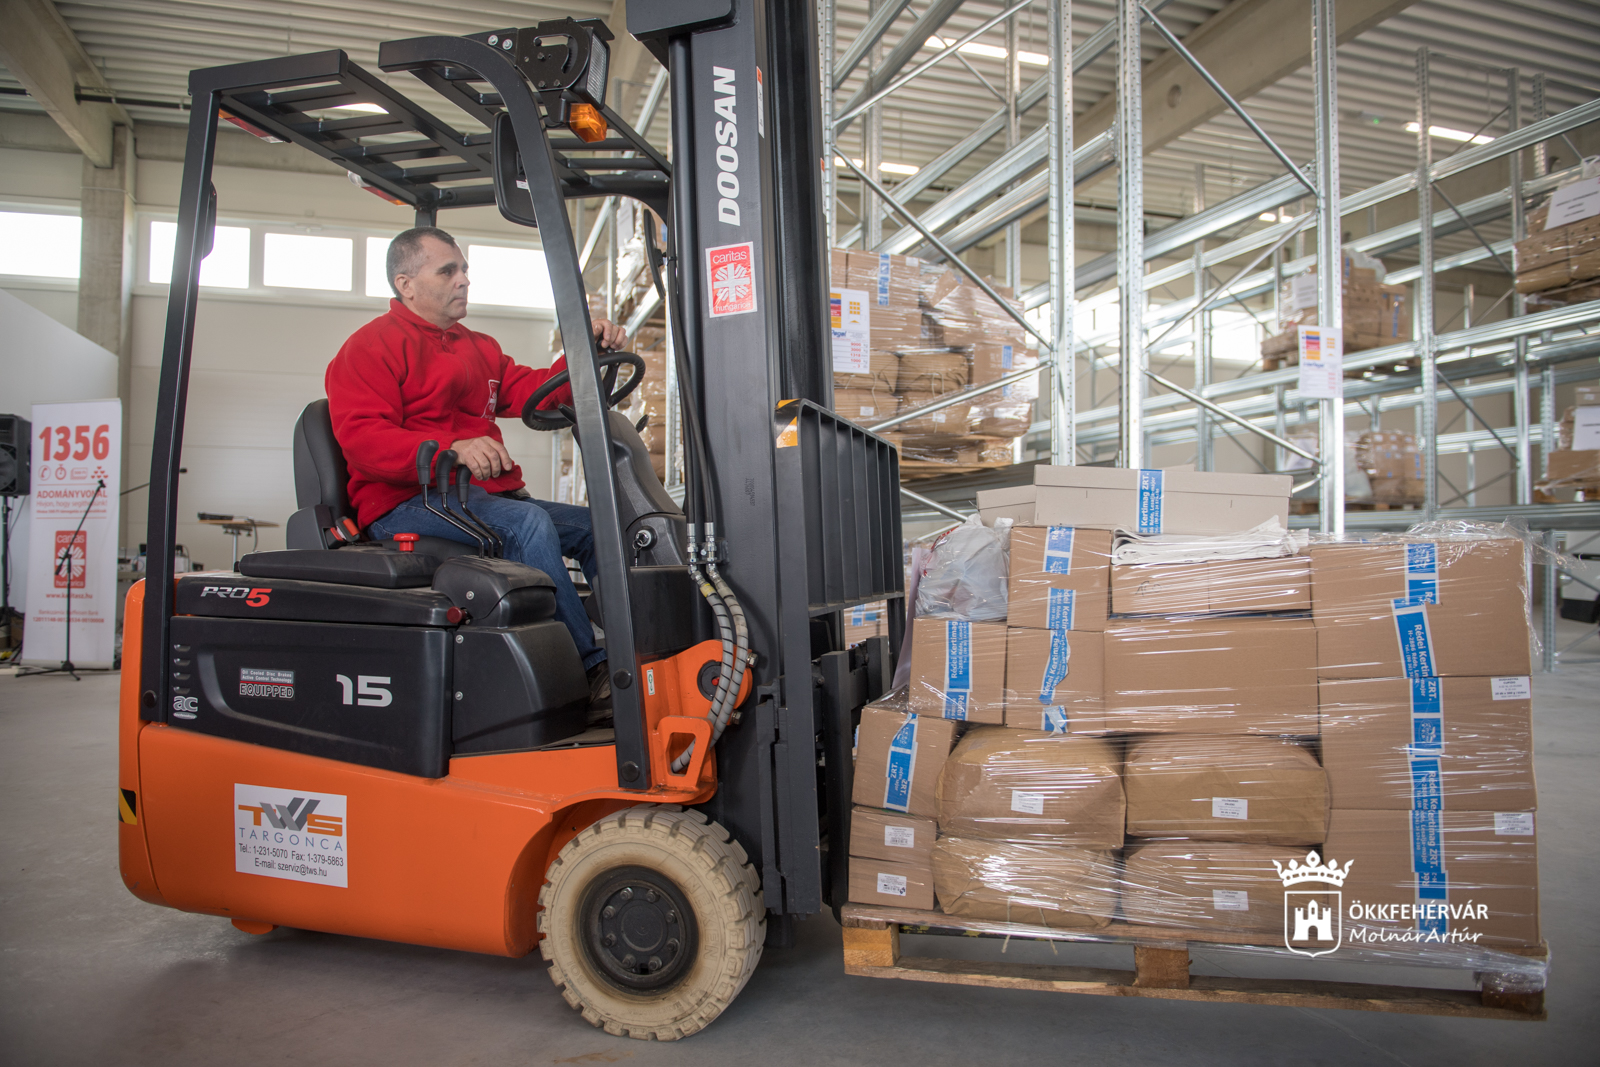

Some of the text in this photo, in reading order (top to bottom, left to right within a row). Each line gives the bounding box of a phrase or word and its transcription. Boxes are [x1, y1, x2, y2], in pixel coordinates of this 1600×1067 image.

[713, 66, 740, 226] DOOSAN
[713, 251, 747, 264] caritas
[38, 424, 109, 461] 1356
[1141, 492, 1149, 526] Kertimag
[57, 534, 84, 543] carias
[200, 586, 272, 607] PRO5
[1414, 624, 1426, 649] Rédei
[240, 683, 294, 698] EQUIPPED
[336, 674, 393, 707] 15
[1428, 681, 1437, 701] ZRT.
[173, 696, 198, 712] ac
[890, 762, 898, 778] ZRT.
[238, 797, 343, 837] TWS
[239, 827, 343, 851] TARGONCA
[239, 843, 344, 867] Tel.: 1-231-5070 Fax: 1-379-5863
[1430, 849, 1438, 868] ZRT.
[255, 858, 327, 877] E-mail: szerviz@tws.hu
[684, 875, 720, 961] NEXEN
